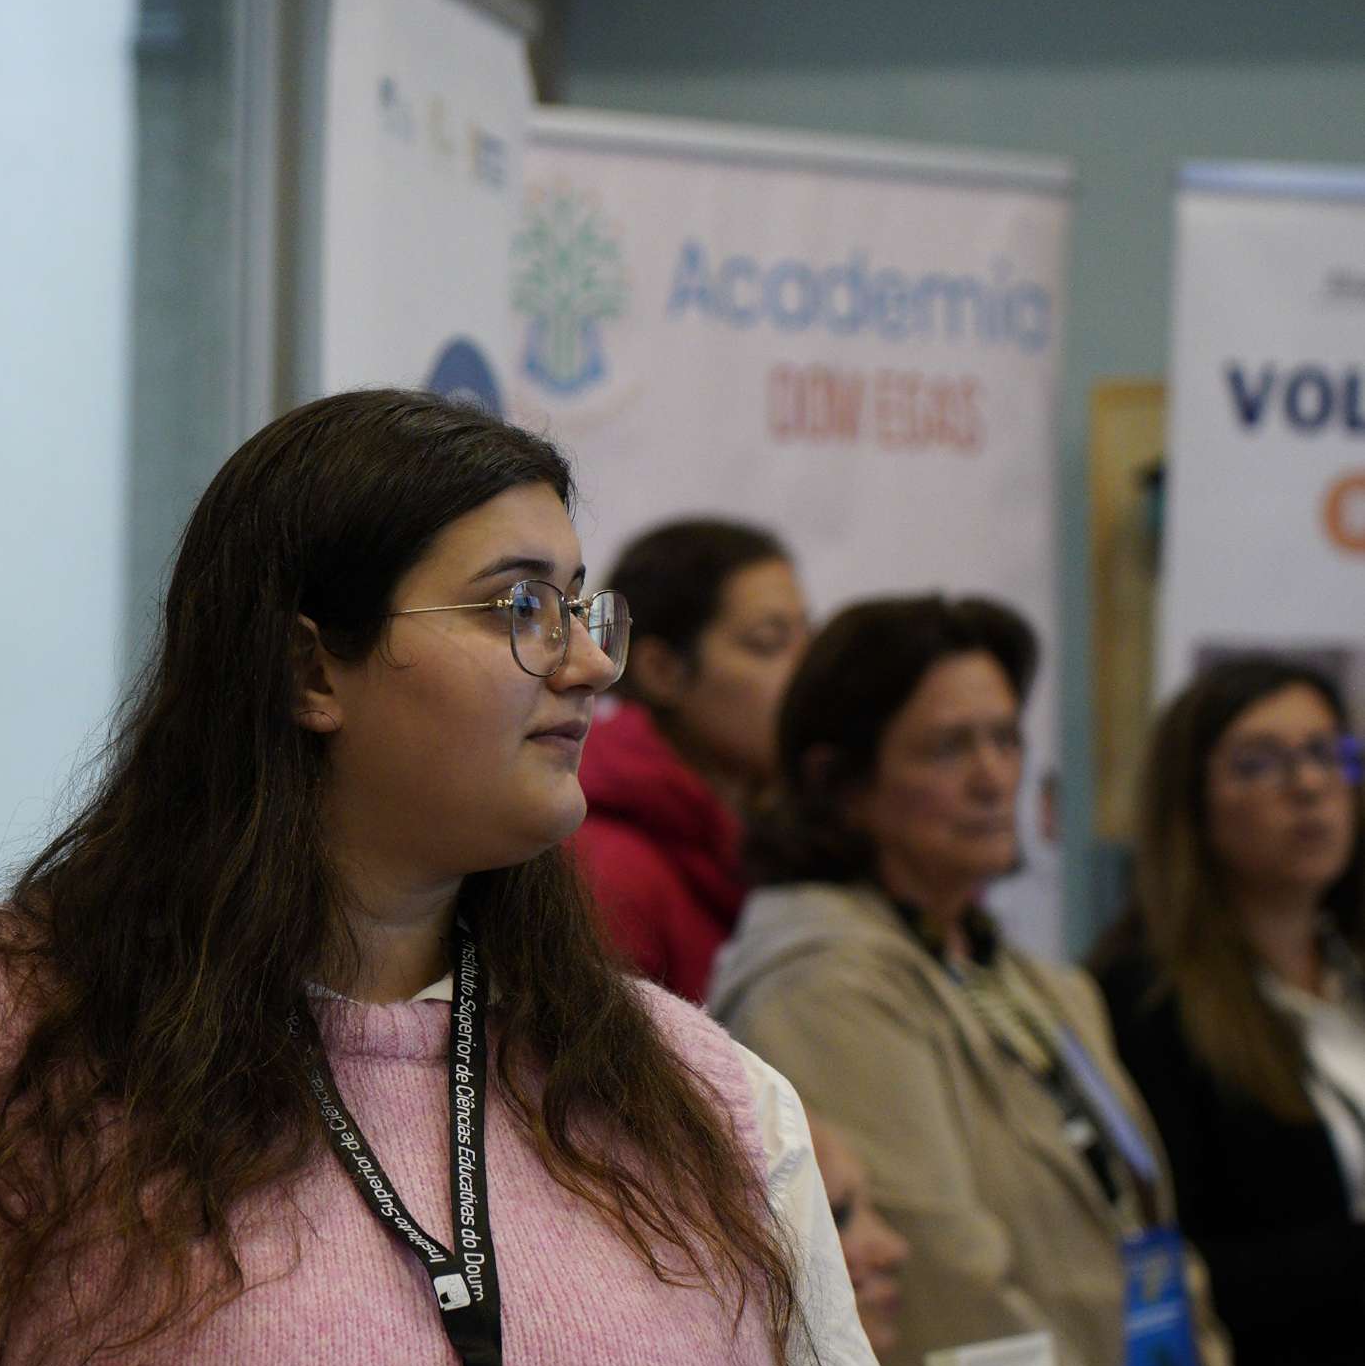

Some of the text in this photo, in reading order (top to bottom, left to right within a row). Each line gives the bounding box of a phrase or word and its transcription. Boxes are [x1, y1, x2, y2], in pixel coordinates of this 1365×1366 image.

[453, 995, 477, 1063] Superior
[455, 1064, 474, 1083] de
[341, 1131, 360, 1151] de
[455, 1085, 475, 1145] Ciências
[352, 1152, 400, 1217] Superior
[457, 1146, 479, 1232] Educativas
[394, 1216, 447, 1264] Instituto
[461, 1228, 481, 1248] do
